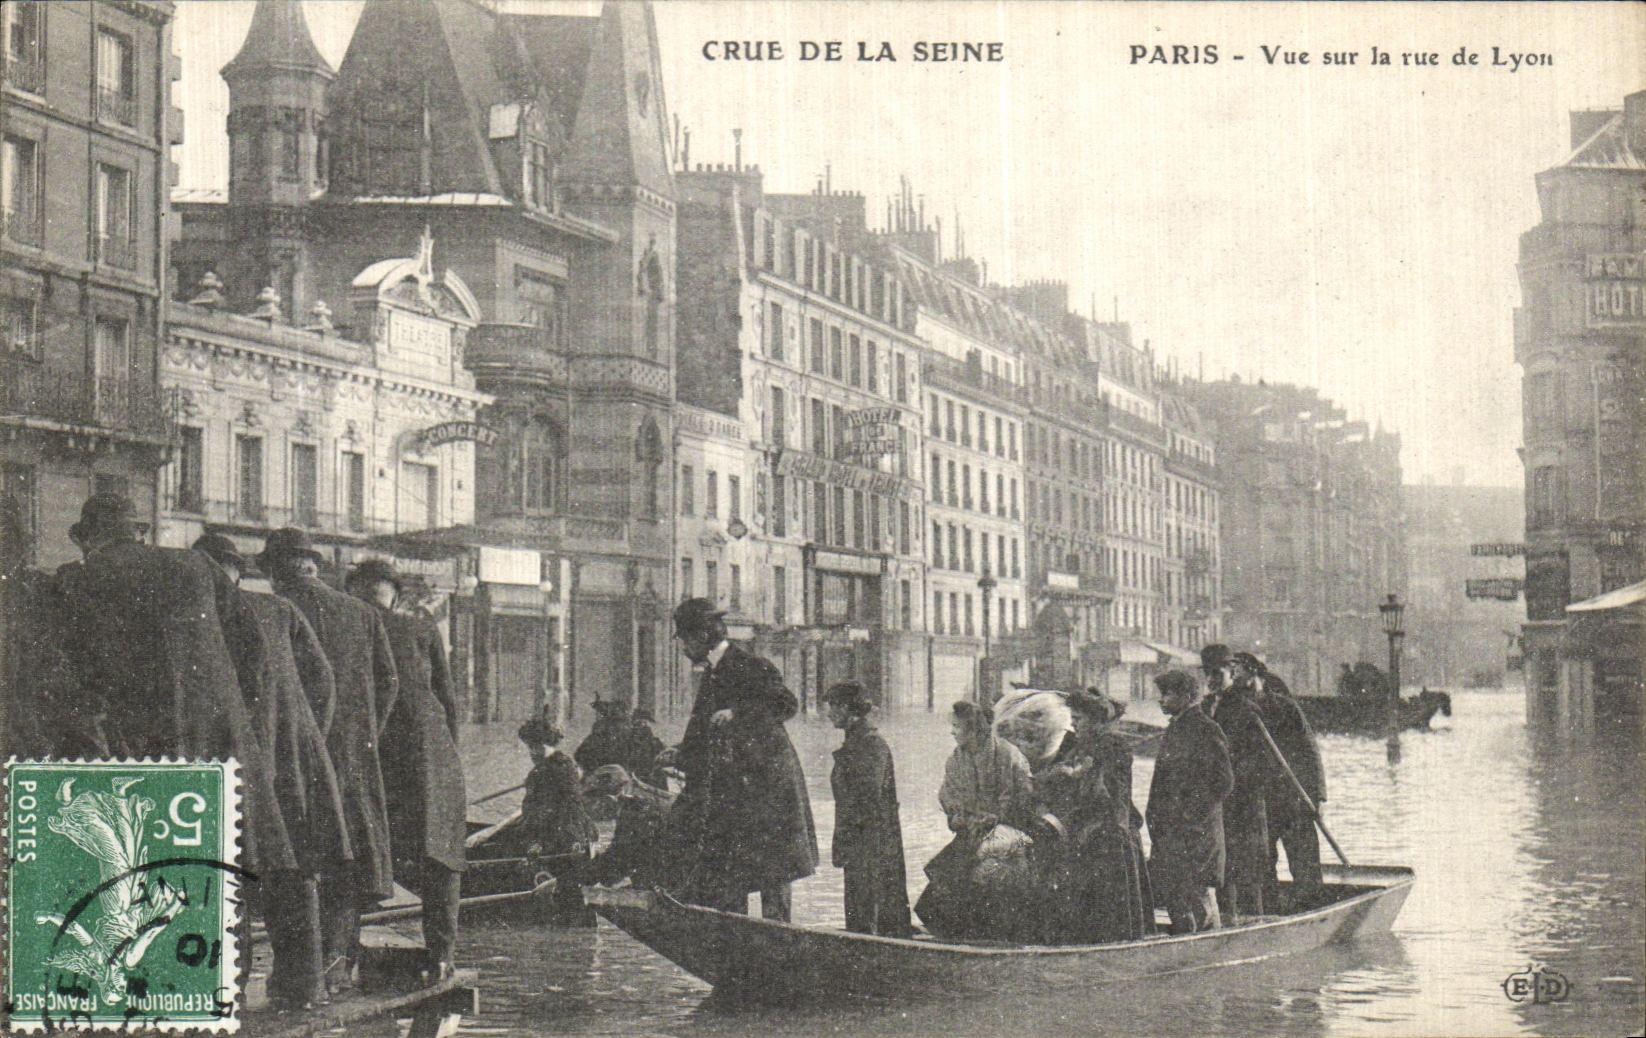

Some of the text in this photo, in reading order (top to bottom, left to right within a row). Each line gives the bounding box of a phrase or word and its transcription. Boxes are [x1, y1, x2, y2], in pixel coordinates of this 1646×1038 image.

[427, 422, 498, 446] CONCERT
[850, 441, 902, 454] FRANCE
[17, 779, 38, 864] POSTES
